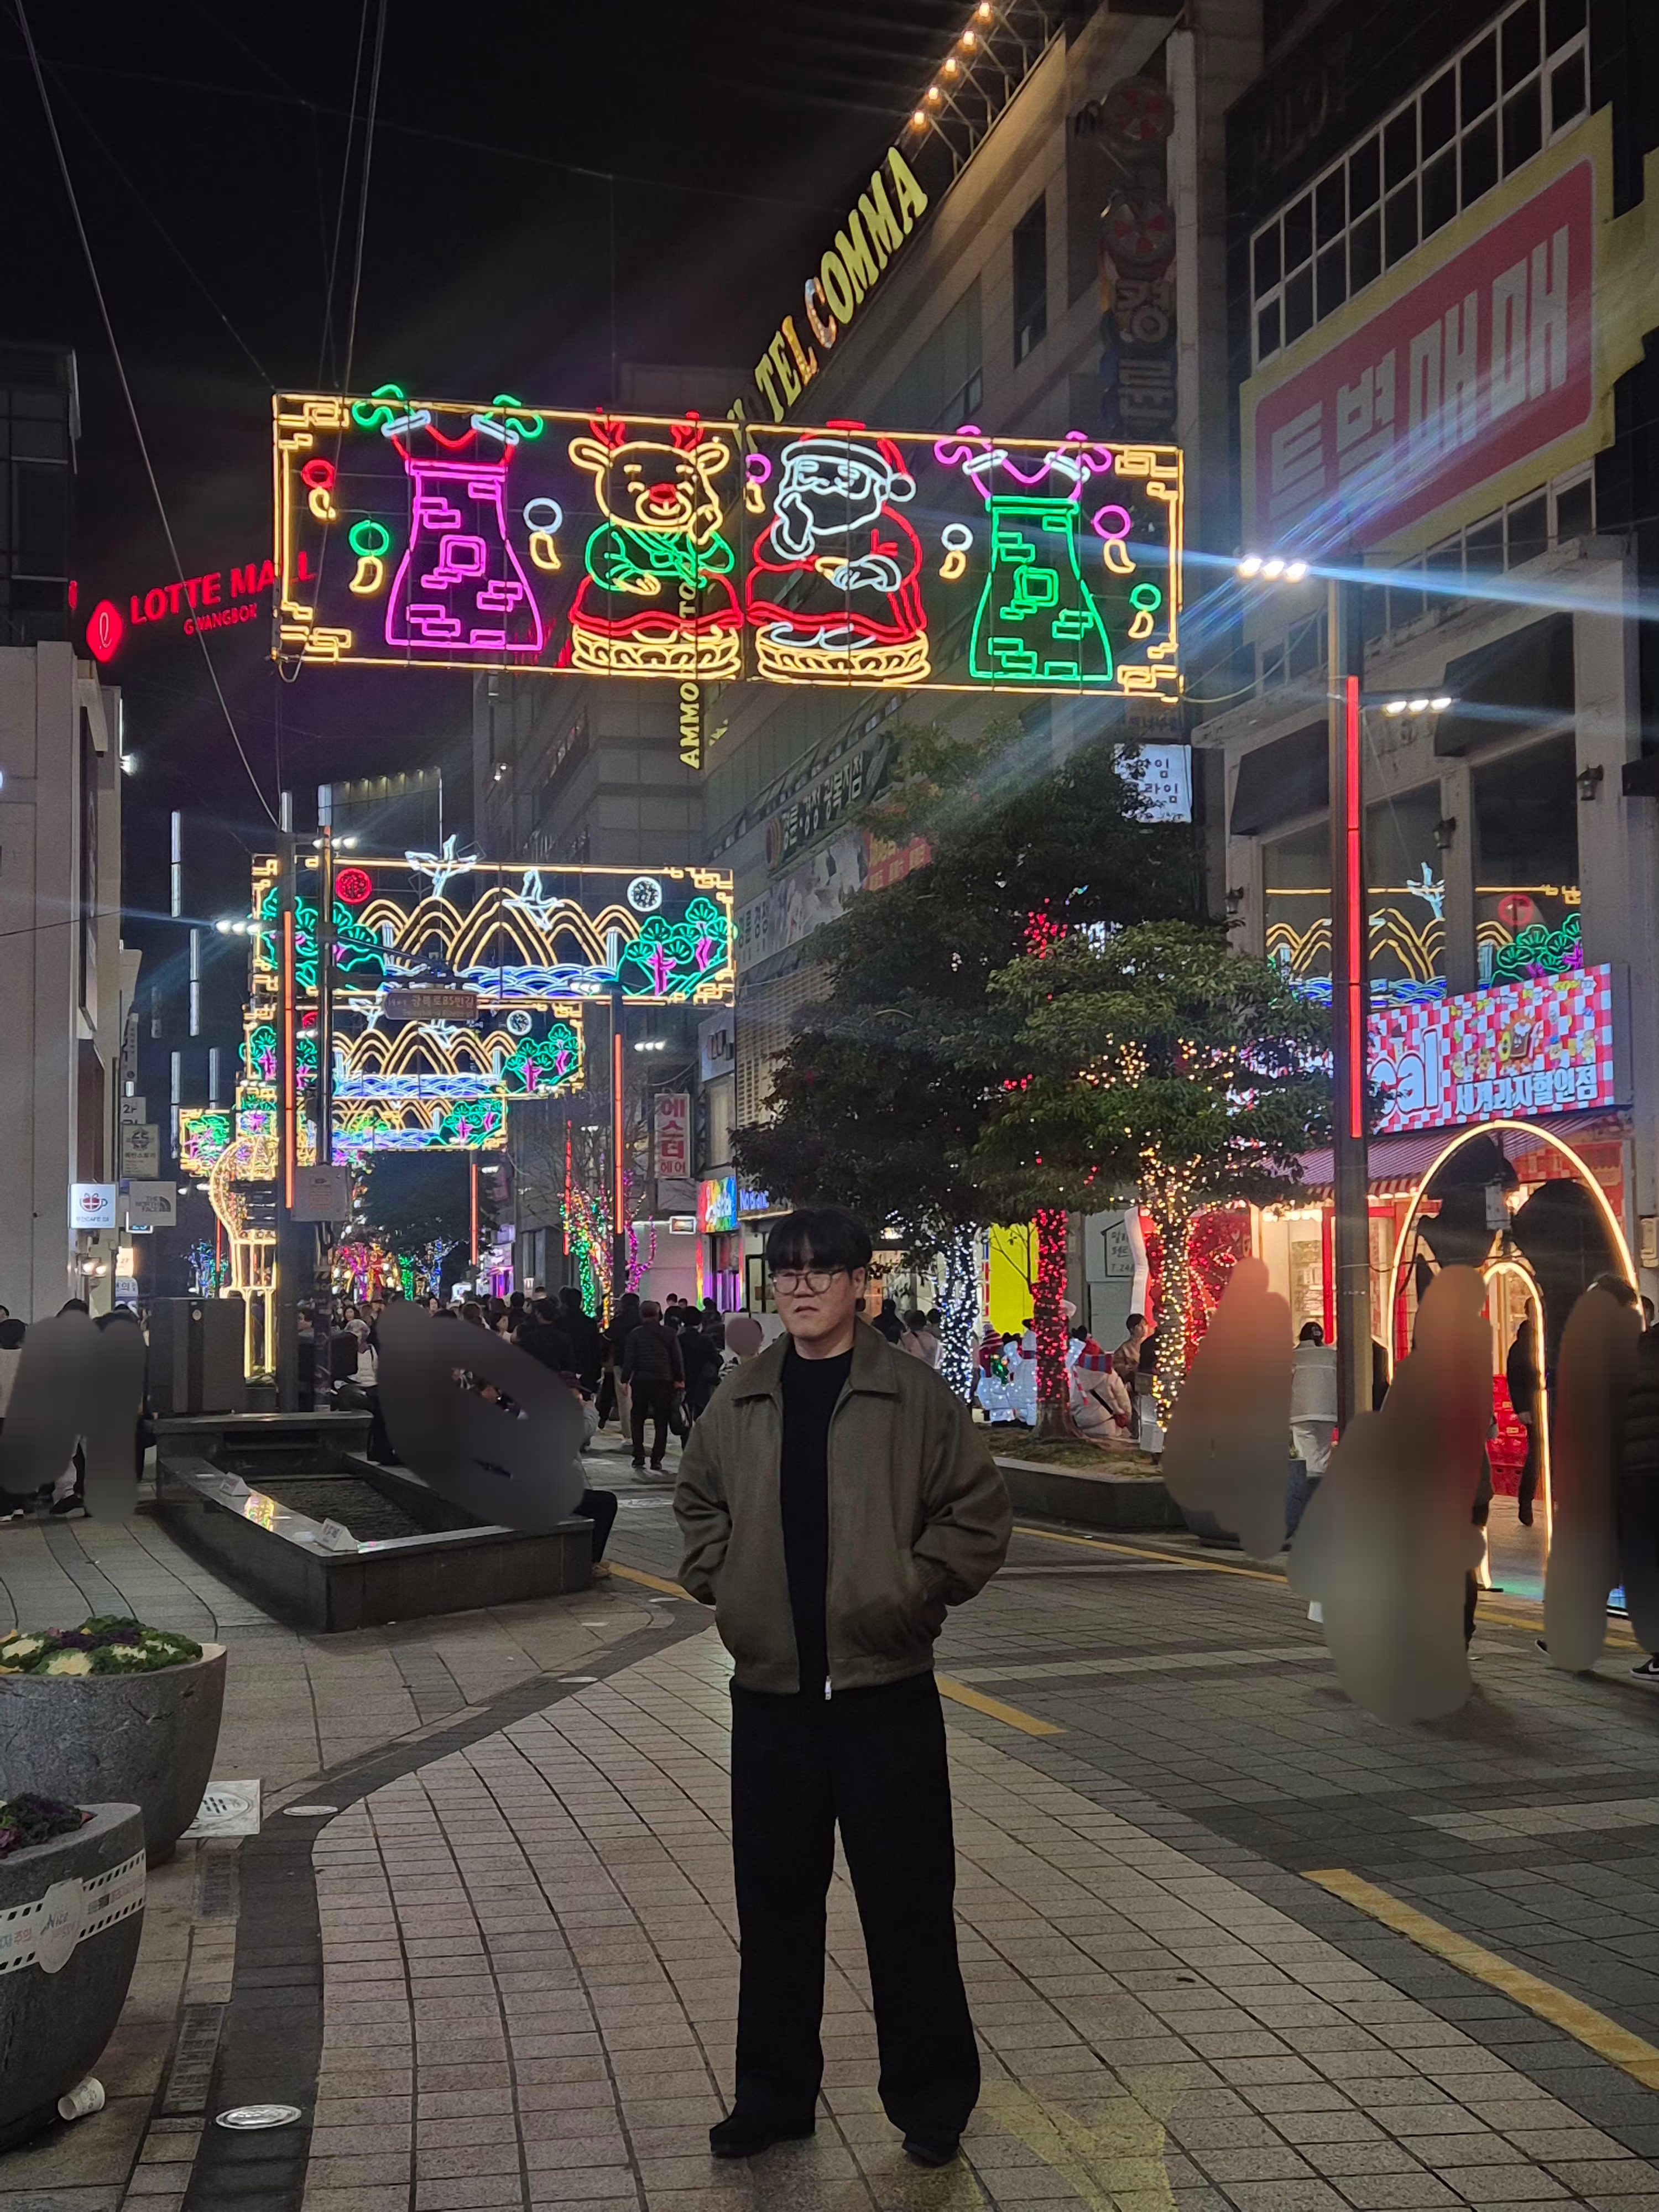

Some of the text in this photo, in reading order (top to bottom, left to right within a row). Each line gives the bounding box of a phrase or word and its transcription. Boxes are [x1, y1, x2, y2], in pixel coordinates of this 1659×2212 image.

[805, 147, 928, 348] COMMA
[131, 551, 317, 625] LOTTE MAL
